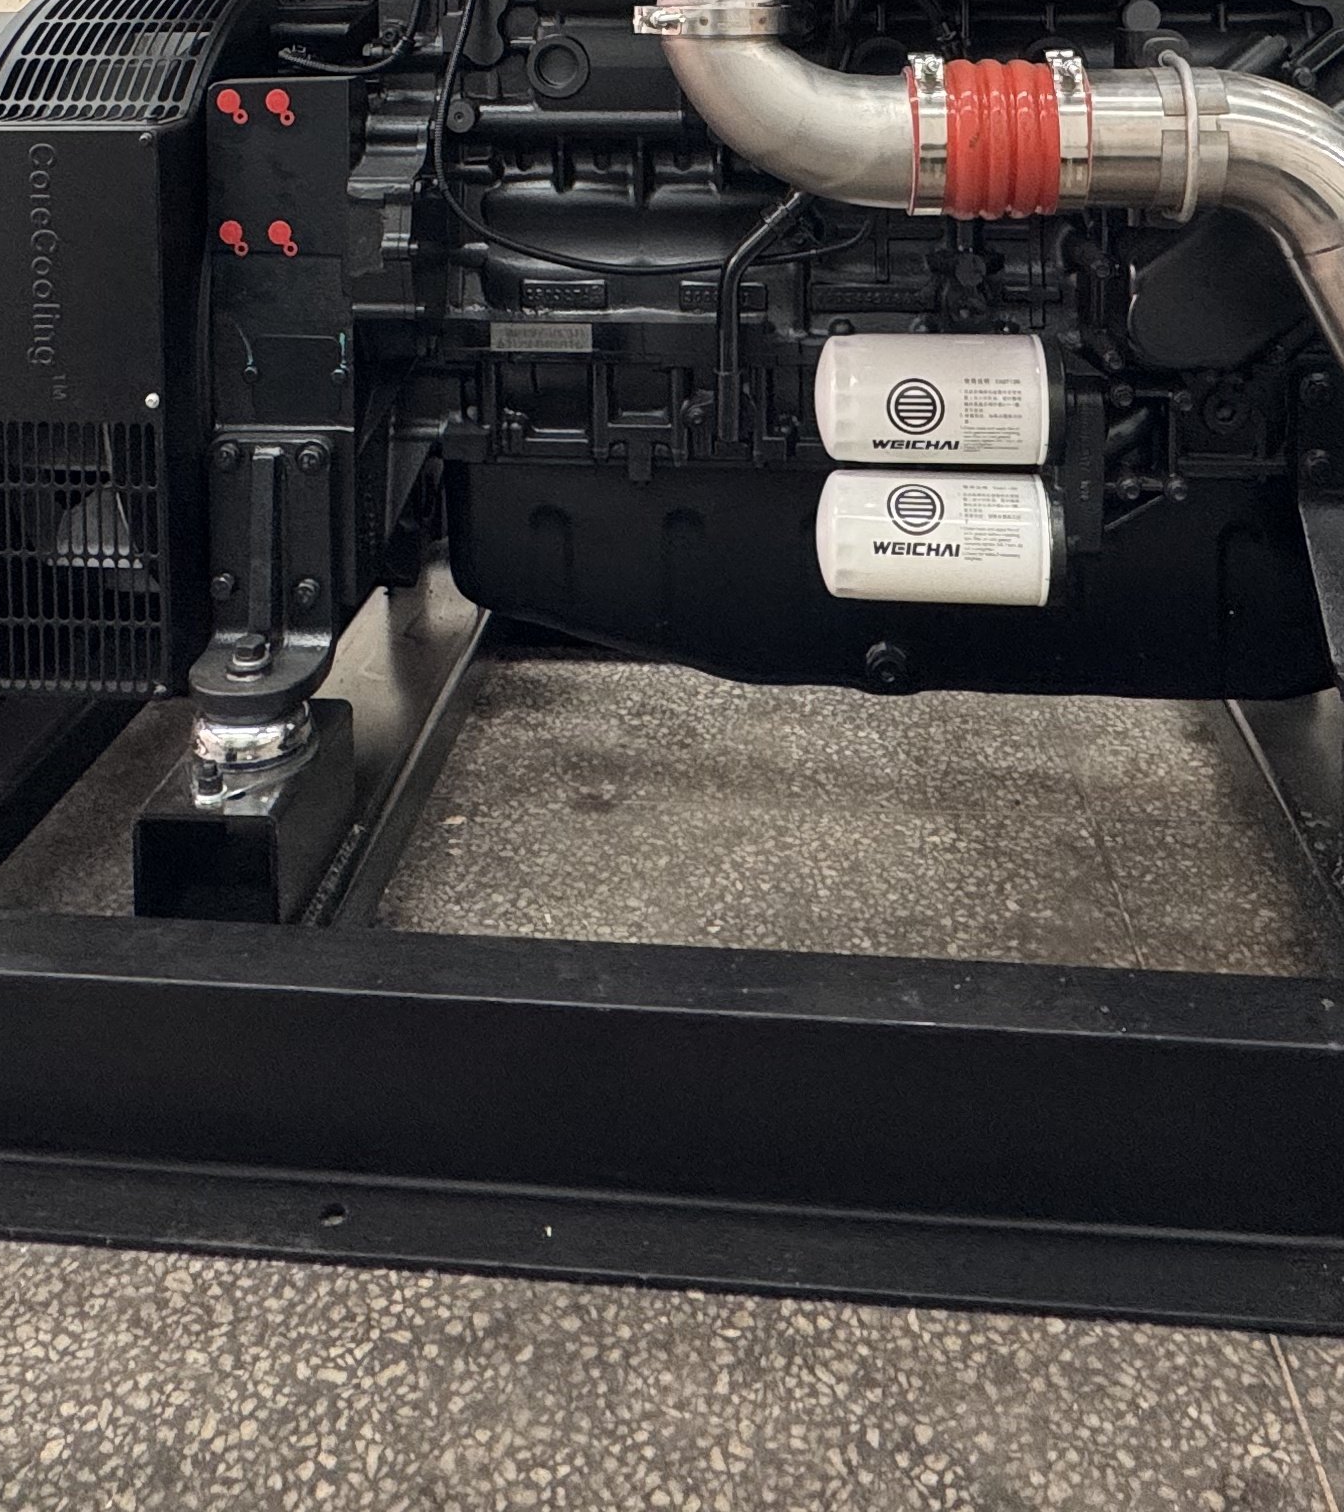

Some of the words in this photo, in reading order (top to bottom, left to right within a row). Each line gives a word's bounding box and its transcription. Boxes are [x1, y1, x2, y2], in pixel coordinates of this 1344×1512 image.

[27, 142, 62, 366] CoreCooling
[872, 439, 960, 451] WEICHAI
[873, 540, 960, 558] WEICHAI
